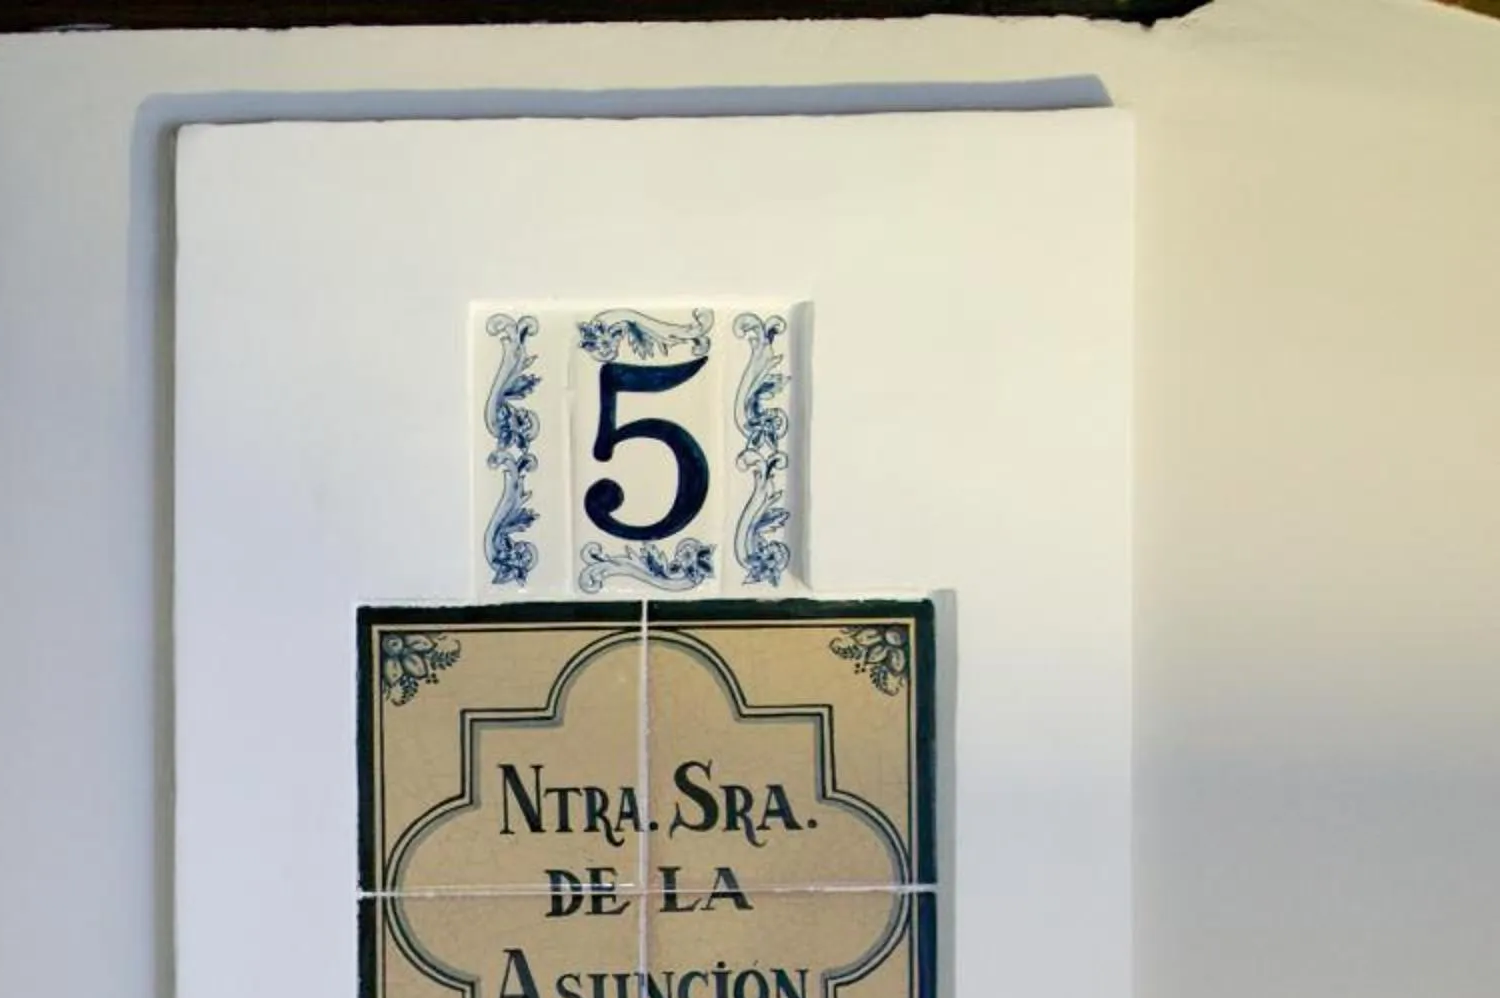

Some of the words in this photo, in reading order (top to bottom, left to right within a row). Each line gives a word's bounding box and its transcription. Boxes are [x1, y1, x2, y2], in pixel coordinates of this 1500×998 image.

[584, 356, 710, 541] 5
[545, 866, 631, 917] DE
[658, 866, 753, 912] LA
